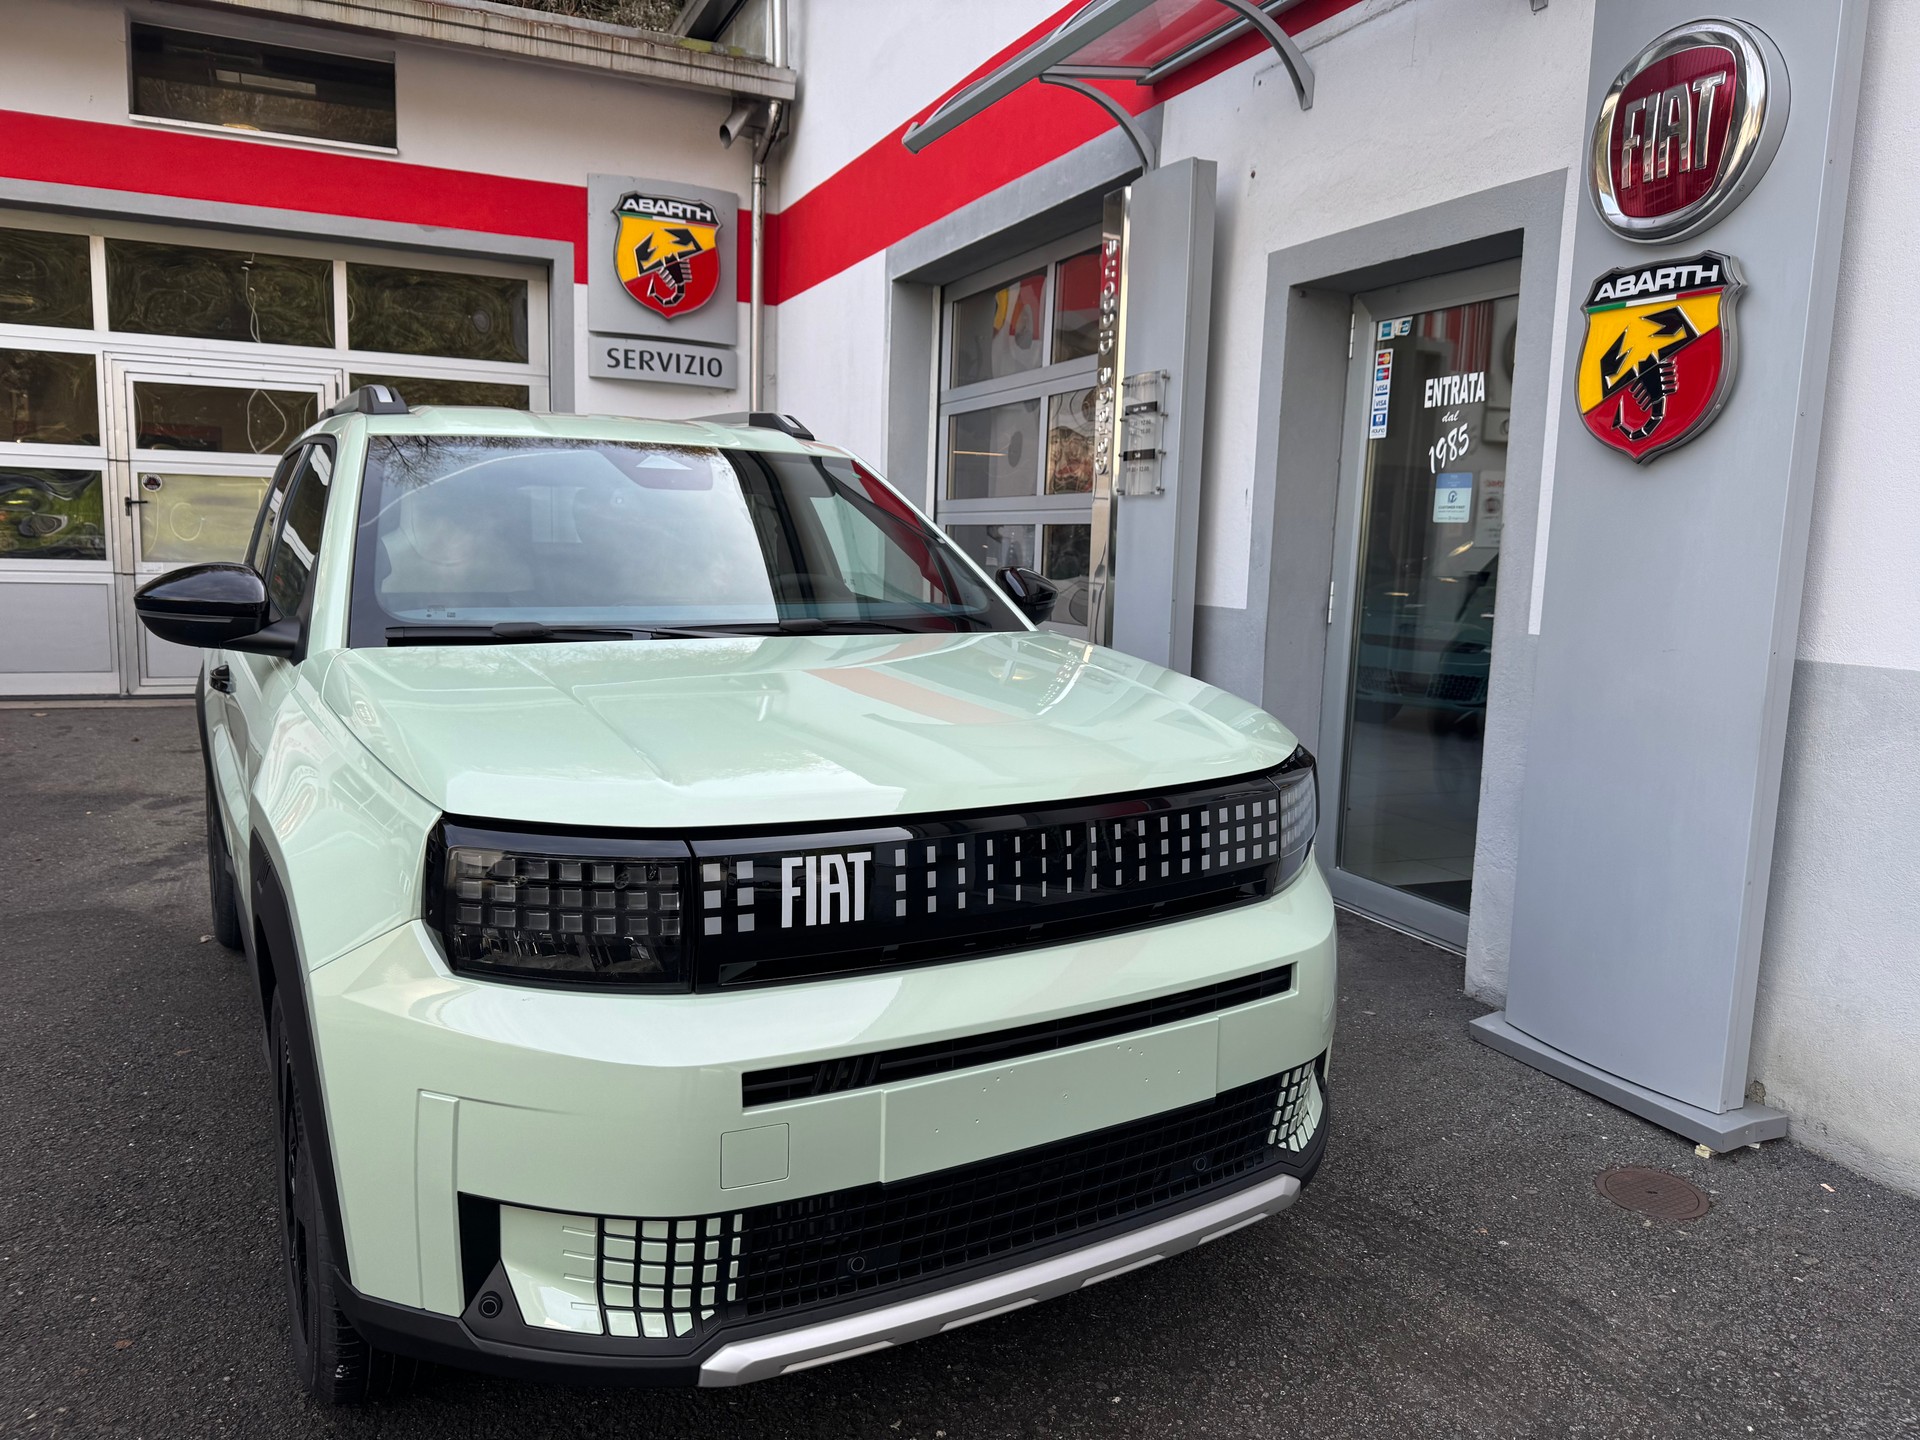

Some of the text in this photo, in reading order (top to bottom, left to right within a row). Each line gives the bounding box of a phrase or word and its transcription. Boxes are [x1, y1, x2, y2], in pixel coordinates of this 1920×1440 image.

[1621, 70, 1726, 191] FIAT
[622, 198, 711, 222] ABARTH
[1594, 264, 1719, 302] ABARTH
[606, 347, 723, 378] SERVIZIO
[1375, 399, 1387, 407] VISA
[1376, 384, 1388, 392] VISA
[1424, 371, 1486, 409] ENTRATA
[1441, 410, 1460, 423] dal
[1428, 423, 1470, 475] 1985
[781, 851, 872, 929] FIAT
